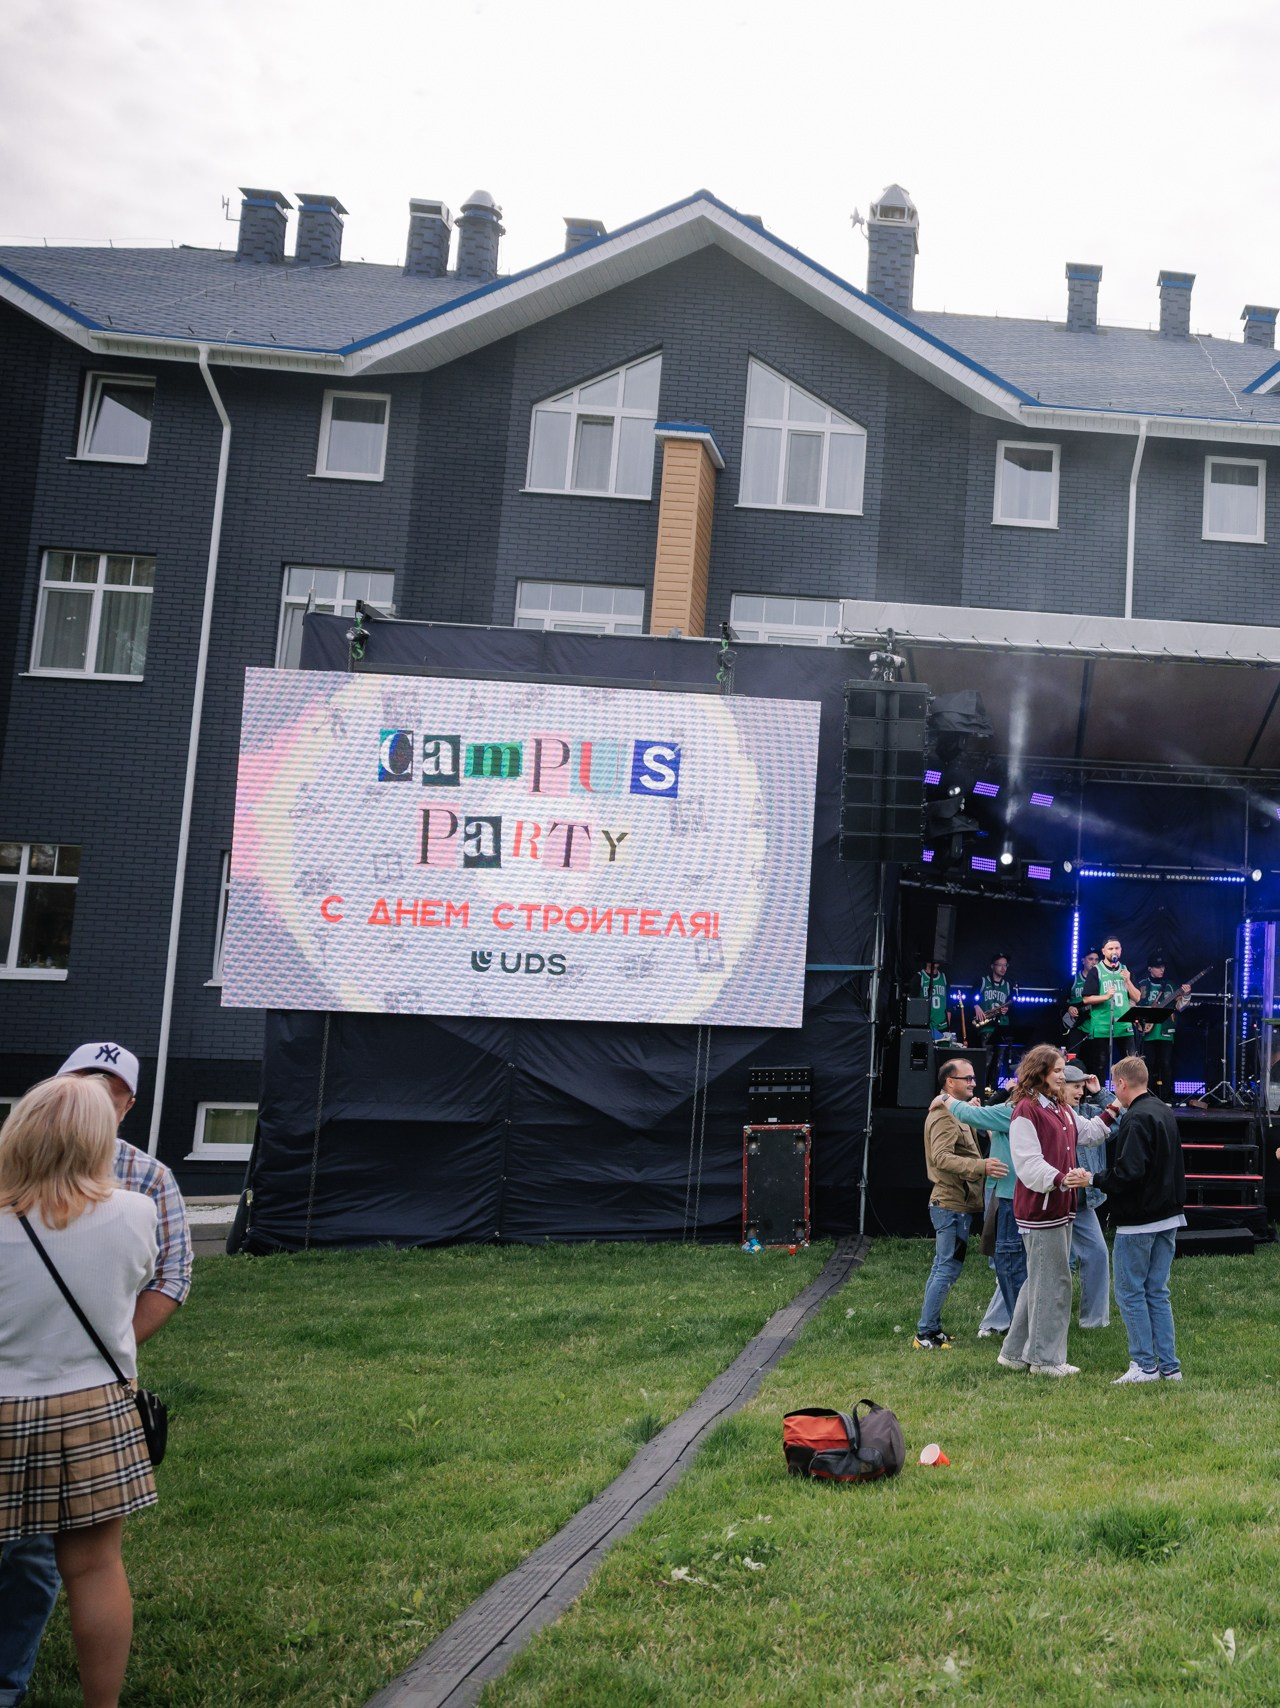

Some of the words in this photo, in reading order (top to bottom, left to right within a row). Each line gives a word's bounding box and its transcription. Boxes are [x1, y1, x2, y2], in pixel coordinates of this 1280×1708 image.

[320, 895, 344, 924] С
[367, 898, 470, 928] ДНЕМ
[491, 902, 720, 939] СТРОИТЕЛЯ!
[501, 952, 567, 976] UDS
[932, 996, 940, 1009] 0
[95, 1044, 121, 1065] NY
